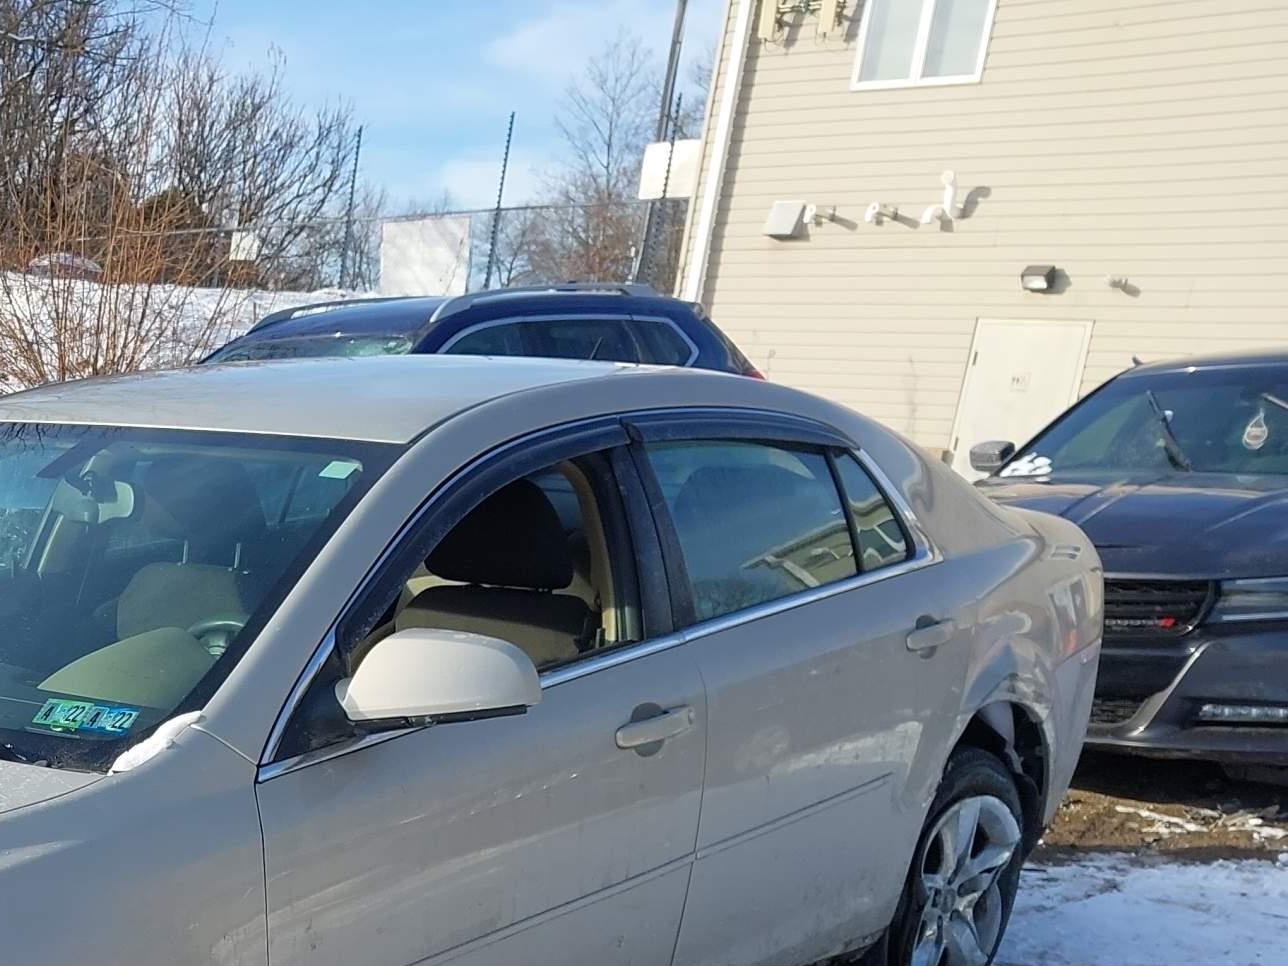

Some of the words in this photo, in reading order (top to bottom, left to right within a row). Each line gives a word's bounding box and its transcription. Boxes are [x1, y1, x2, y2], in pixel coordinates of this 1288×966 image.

[41, 706, 54, 721] 4
[65, 706, 86, 722] 22
[88, 711, 101, 727] 4
[112, 712, 133, 729] 22
